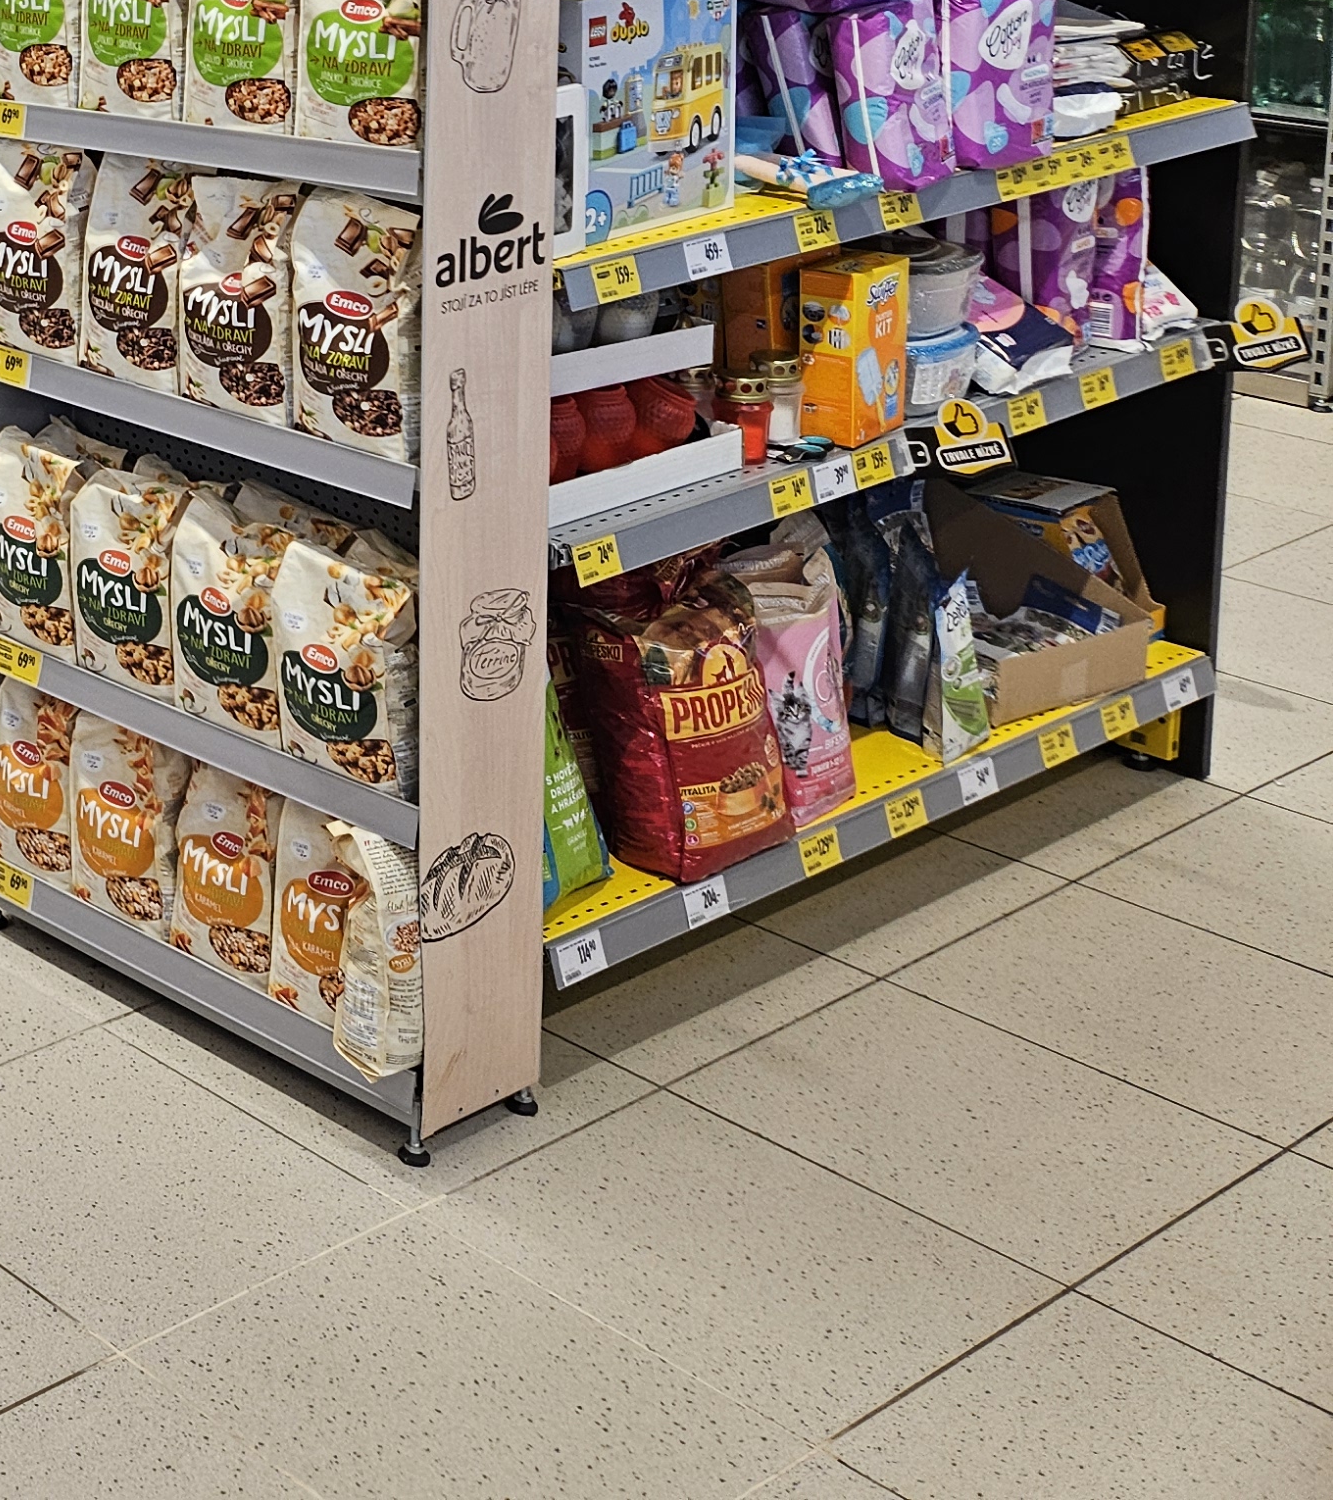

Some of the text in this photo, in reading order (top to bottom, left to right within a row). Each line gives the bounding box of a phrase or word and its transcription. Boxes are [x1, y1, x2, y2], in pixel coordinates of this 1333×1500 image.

[345, 3, 383, 19] Emco
[314, 21, 397, 62] MYSLI
[611, 22, 649, 44] duplo
[322, 55, 341, 69] NA
[435, 221, 546, 288] albert
[331, 294, 370, 314] Emco
[441, 295, 467, 314] STOJÍ
[467, 293, 482, 308] ZA
[483, 289, 498, 304] TO
[519, 279, 539, 296] LÉPE
[299, 307, 374, 355] MYSLI
[874, 319, 893, 338] KIT
[943, 442, 1002, 463] TRVALE NÍZKÉ
[184, 605, 252, 655] MYSLI
[306, 648, 335, 668] Emco
[474, 649, 519, 673] Terrine
[285, 661, 360, 711] MYSLI
[101, 784, 133, 804] Emco
[80, 797, 141, 849] MYSLI
[184, 837, 248, 896] MYSLI
[312, 873, 353, 893] Emco
